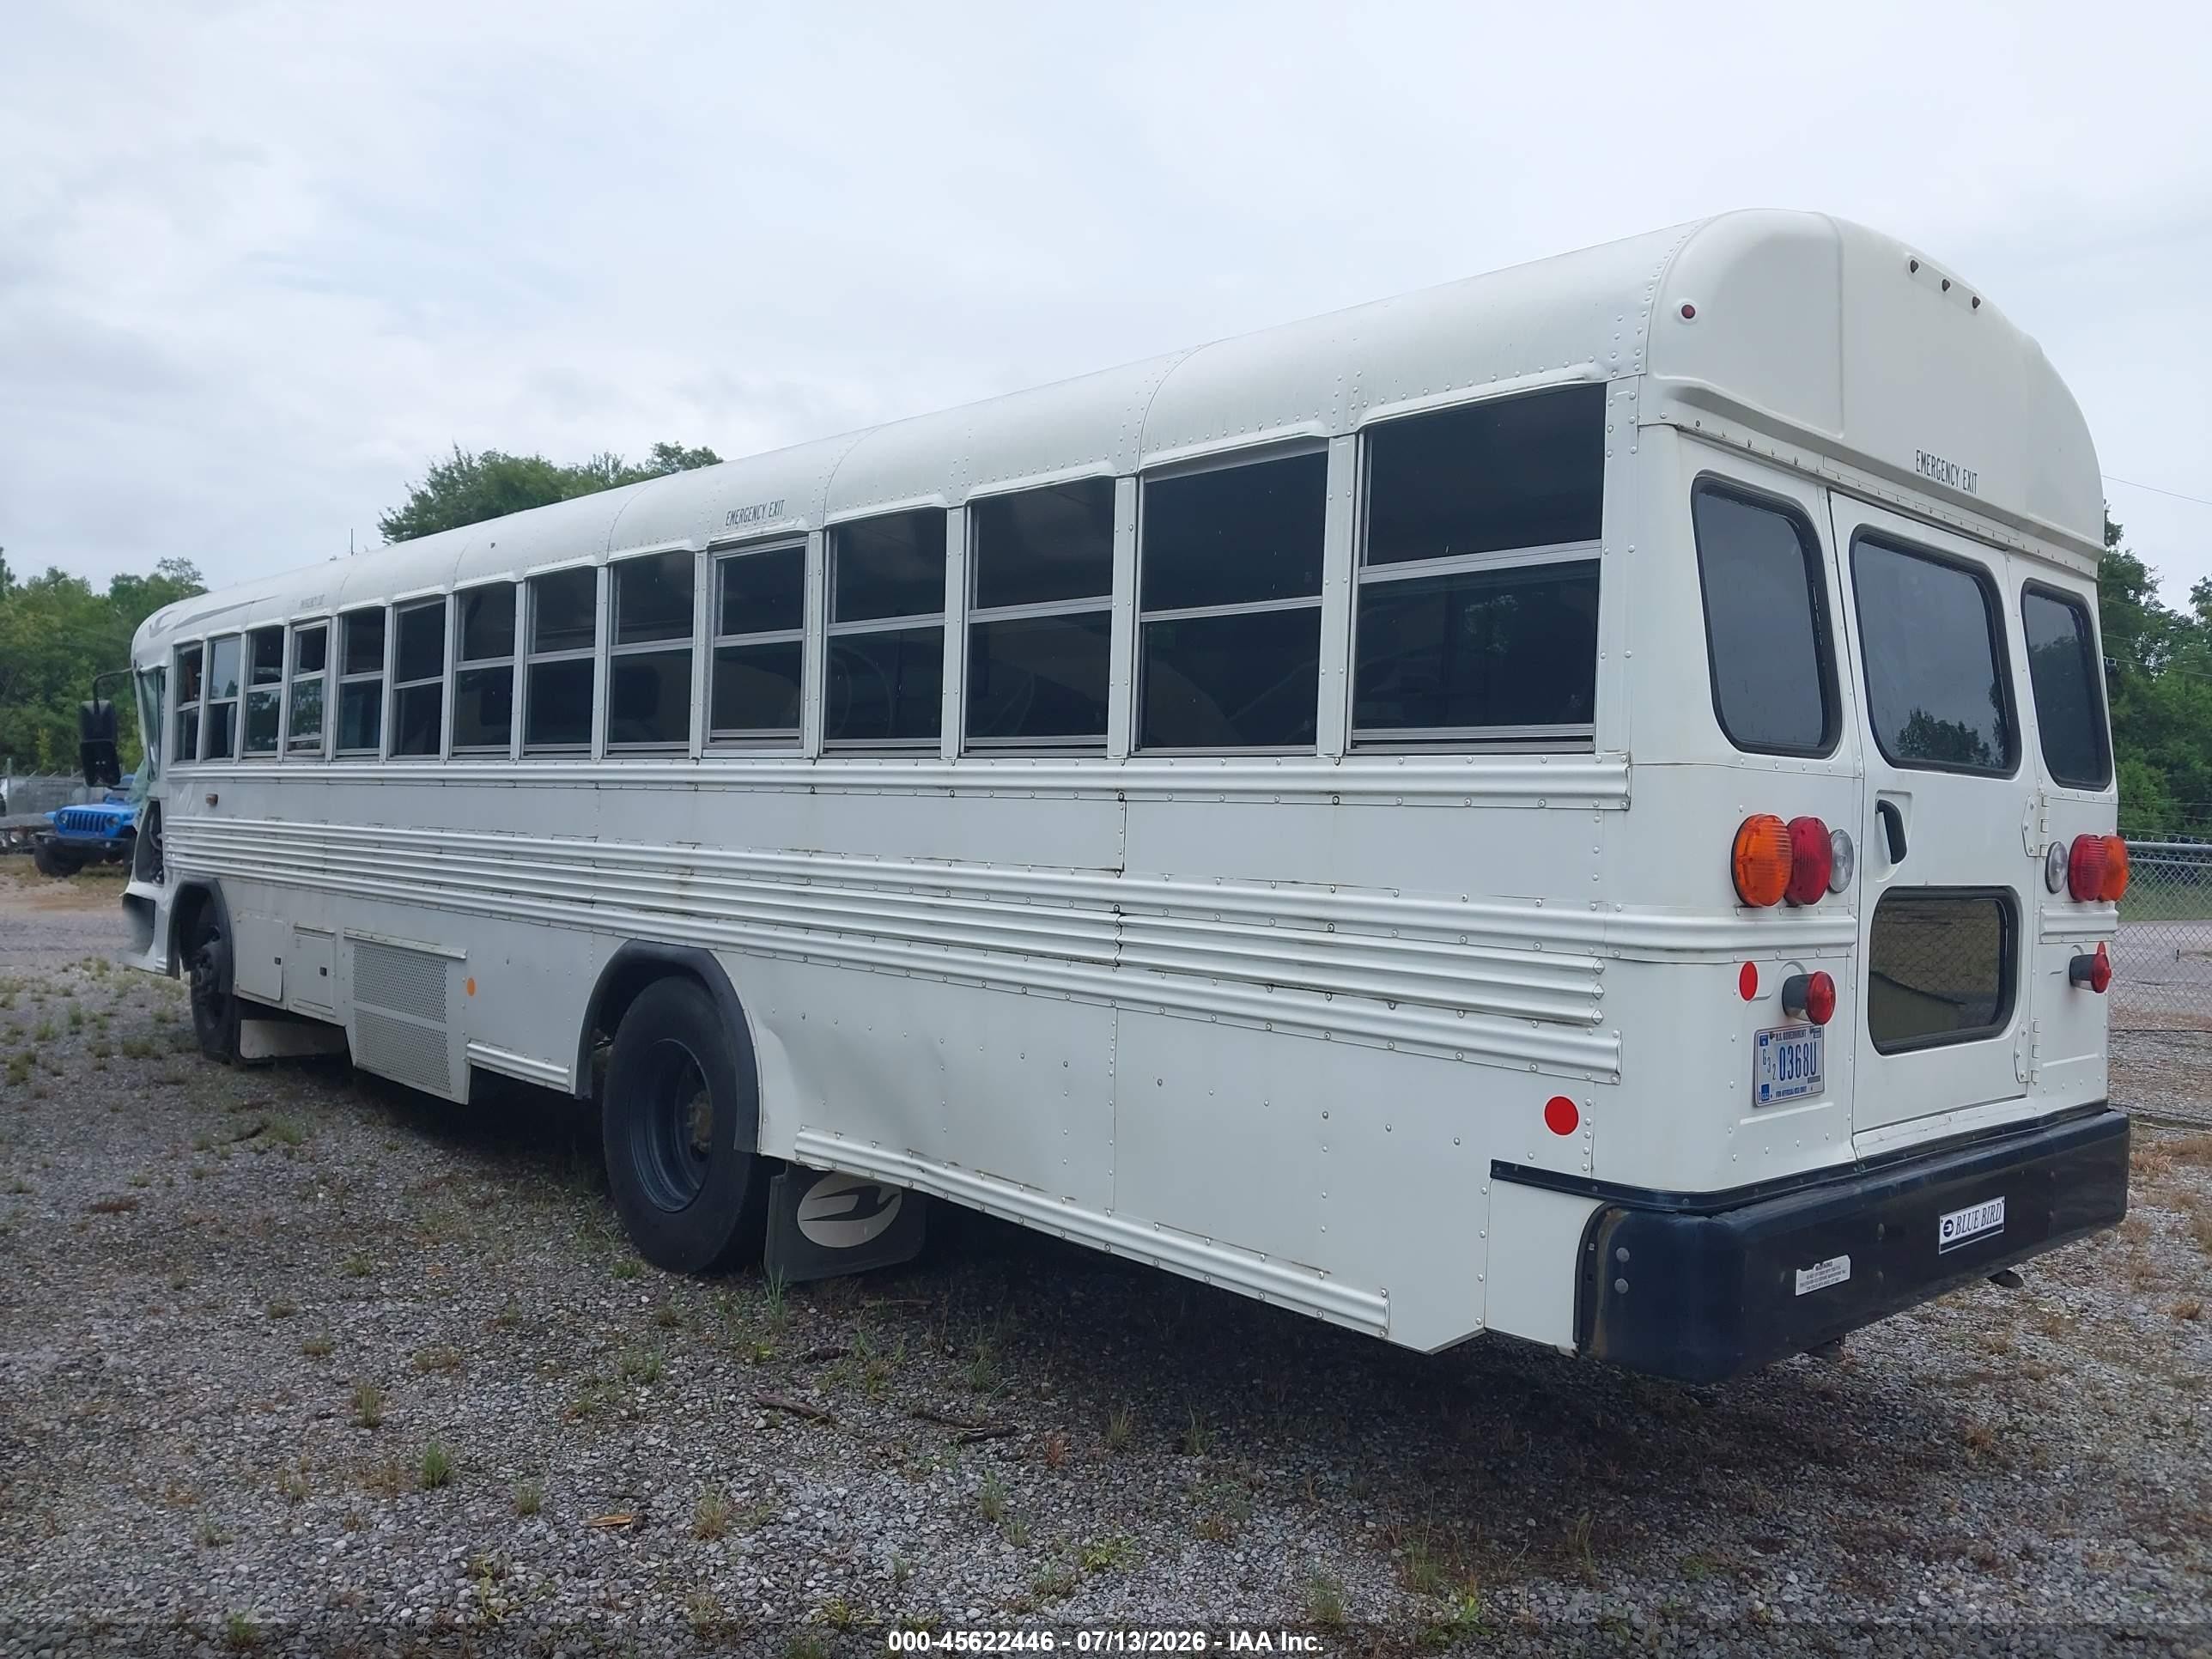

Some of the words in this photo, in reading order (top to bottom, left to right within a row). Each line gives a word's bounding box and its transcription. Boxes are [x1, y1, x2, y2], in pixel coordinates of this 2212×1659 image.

[1916, 449, 1960, 487] EMERGENCY
[1963, 468, 1978, 495] EXIT
[726, 502, 767, 526] EMERGENCY
[769, 499, 785, 518] EXIT
[1779, 1042, 1816, 1081] 0368U
[1955, 1210, 1979, 1236] BLUE
[1981, 1202, 2002, 1227] BIRD
